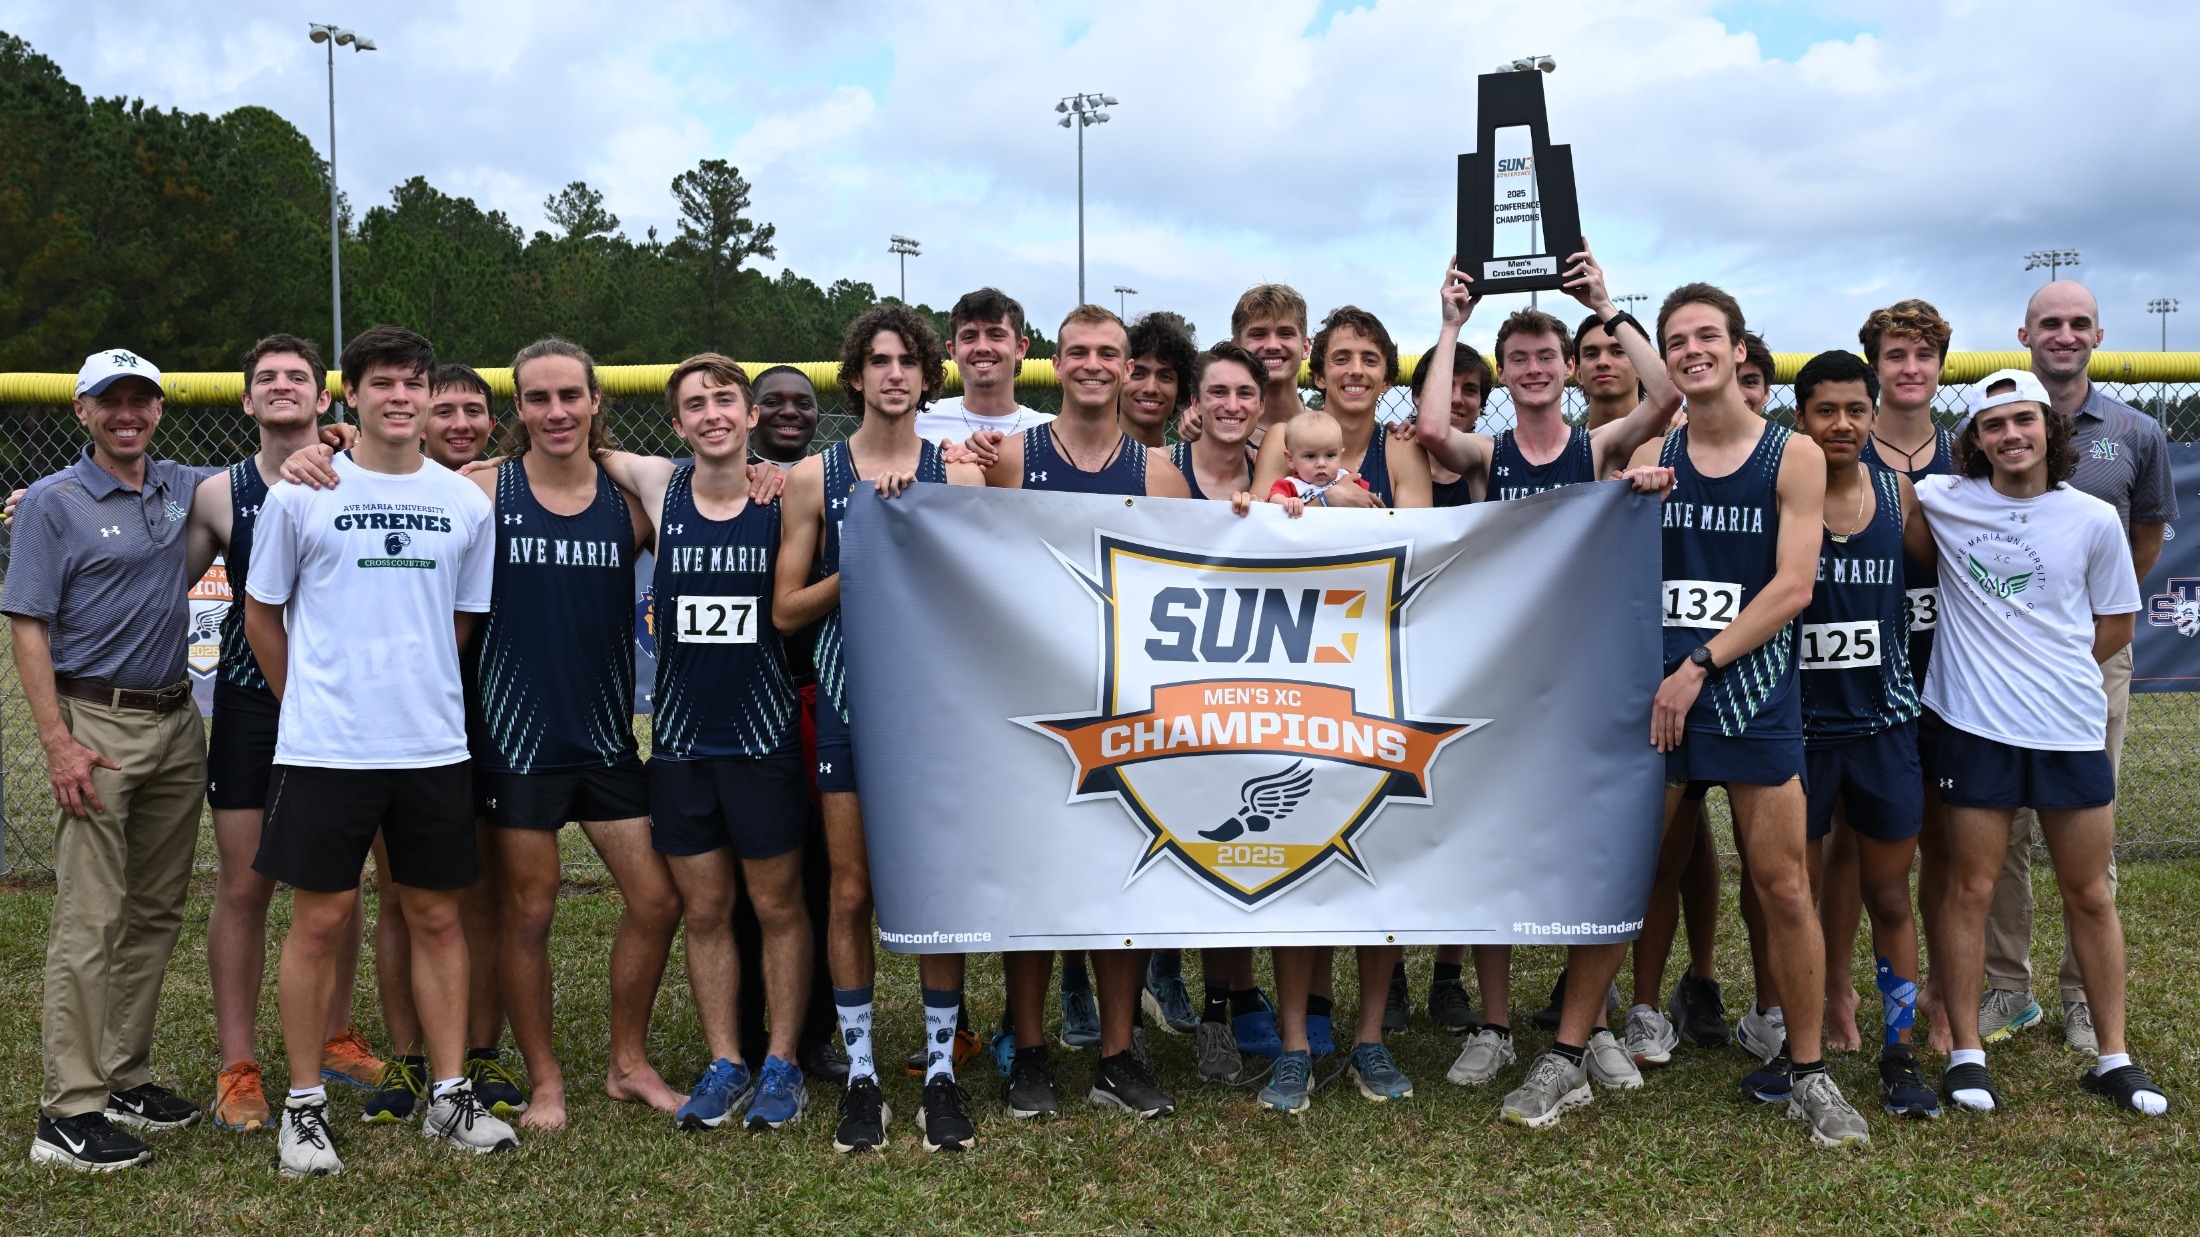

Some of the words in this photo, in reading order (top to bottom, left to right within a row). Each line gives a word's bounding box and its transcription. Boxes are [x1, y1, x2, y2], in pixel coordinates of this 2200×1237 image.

[1497, 157, 1526, 172] SUN
[1507, 189, 1526, 199] 2025
[1494, 201, 1540, 212] CONFERENCE
[1495, 213, 1540, 224] CHAMPIONS
[1492, 269, 1515, 278] Cross
[1516, 267, 1548, 277] Country
[1507, 259, 1532, 268] Men's
[343, 504, 361, 512] AVE
[362, 503, 394, 511] MARIA
[395, 504, 445, 514] UNIVERSITY
[1663, 503, 1694, 528] AVE
[1700, 504, 1763, 533] MARIA
[334, 513, 452, 533] GYRENES
[509, 537, 547, 564] AVE
[555, 539, 621, 567] MARIA
[671, 547, 704, 573] AVE
[710, 546, 767, 573] MARIA
[364, 559, 391, 567] CROSS
[391, 559, 431, 568] COUNTRY
[1968, 533, 2001, 547] MARIA
[2006, 535, 2046, 591] UNIVERSITY
[1667, 587, 1734, 623] 132
[683, 603, 752, 636] 127
[1144, 587, 1321, 664] SUN
[189, 646, 220, 656] 2025
[1804, 628, 1875, 663] 125
[1204, 688, 1269, 706] MEN'S
[1274, 689, 1302, 707] XC
[1101, 711, 1407, 763] CHAMPIONS
[1217, 845, 1285, 865] 2025
[1512, 917, 1644, 935] #TheSunStandard
